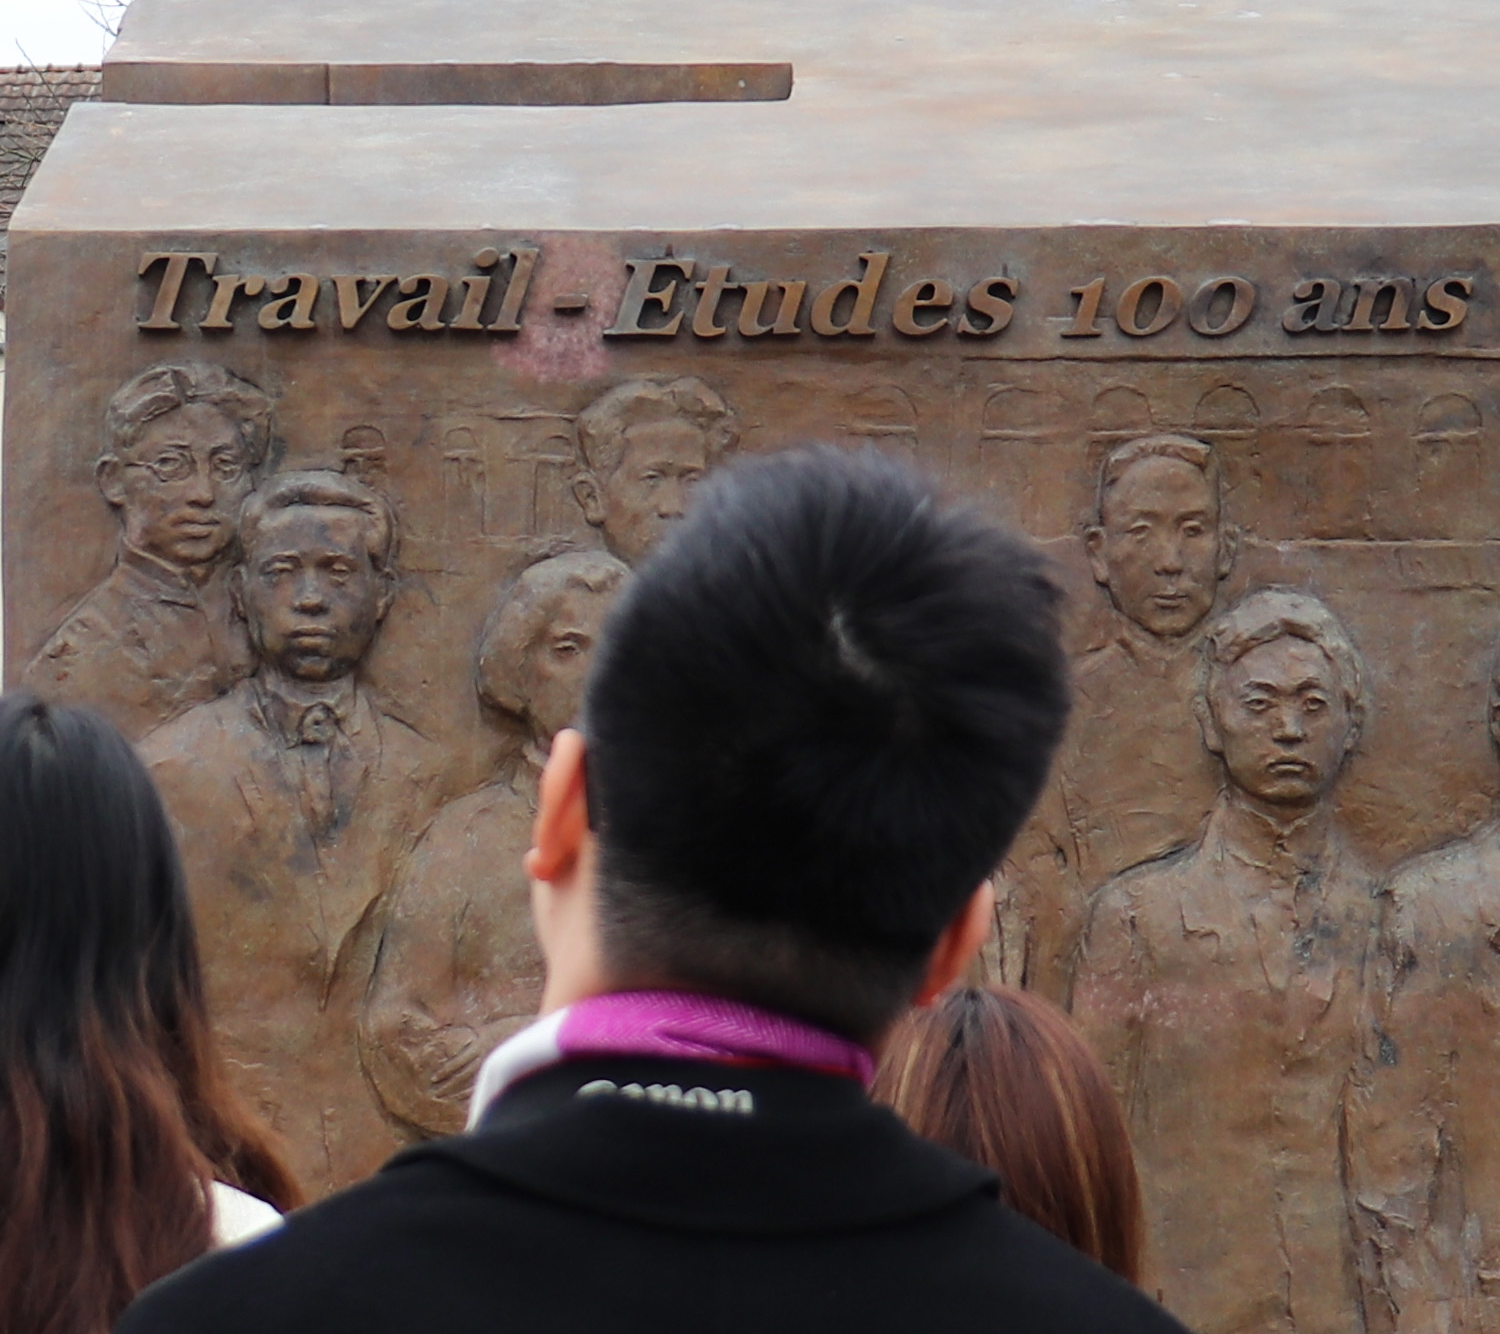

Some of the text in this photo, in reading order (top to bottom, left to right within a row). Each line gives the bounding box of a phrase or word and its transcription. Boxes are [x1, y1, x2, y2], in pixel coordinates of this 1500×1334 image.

[136, 246, 541, 334] Travail
[1060, 274, 1258, 338] 100
[1281, 274, 1476, 334] ans
